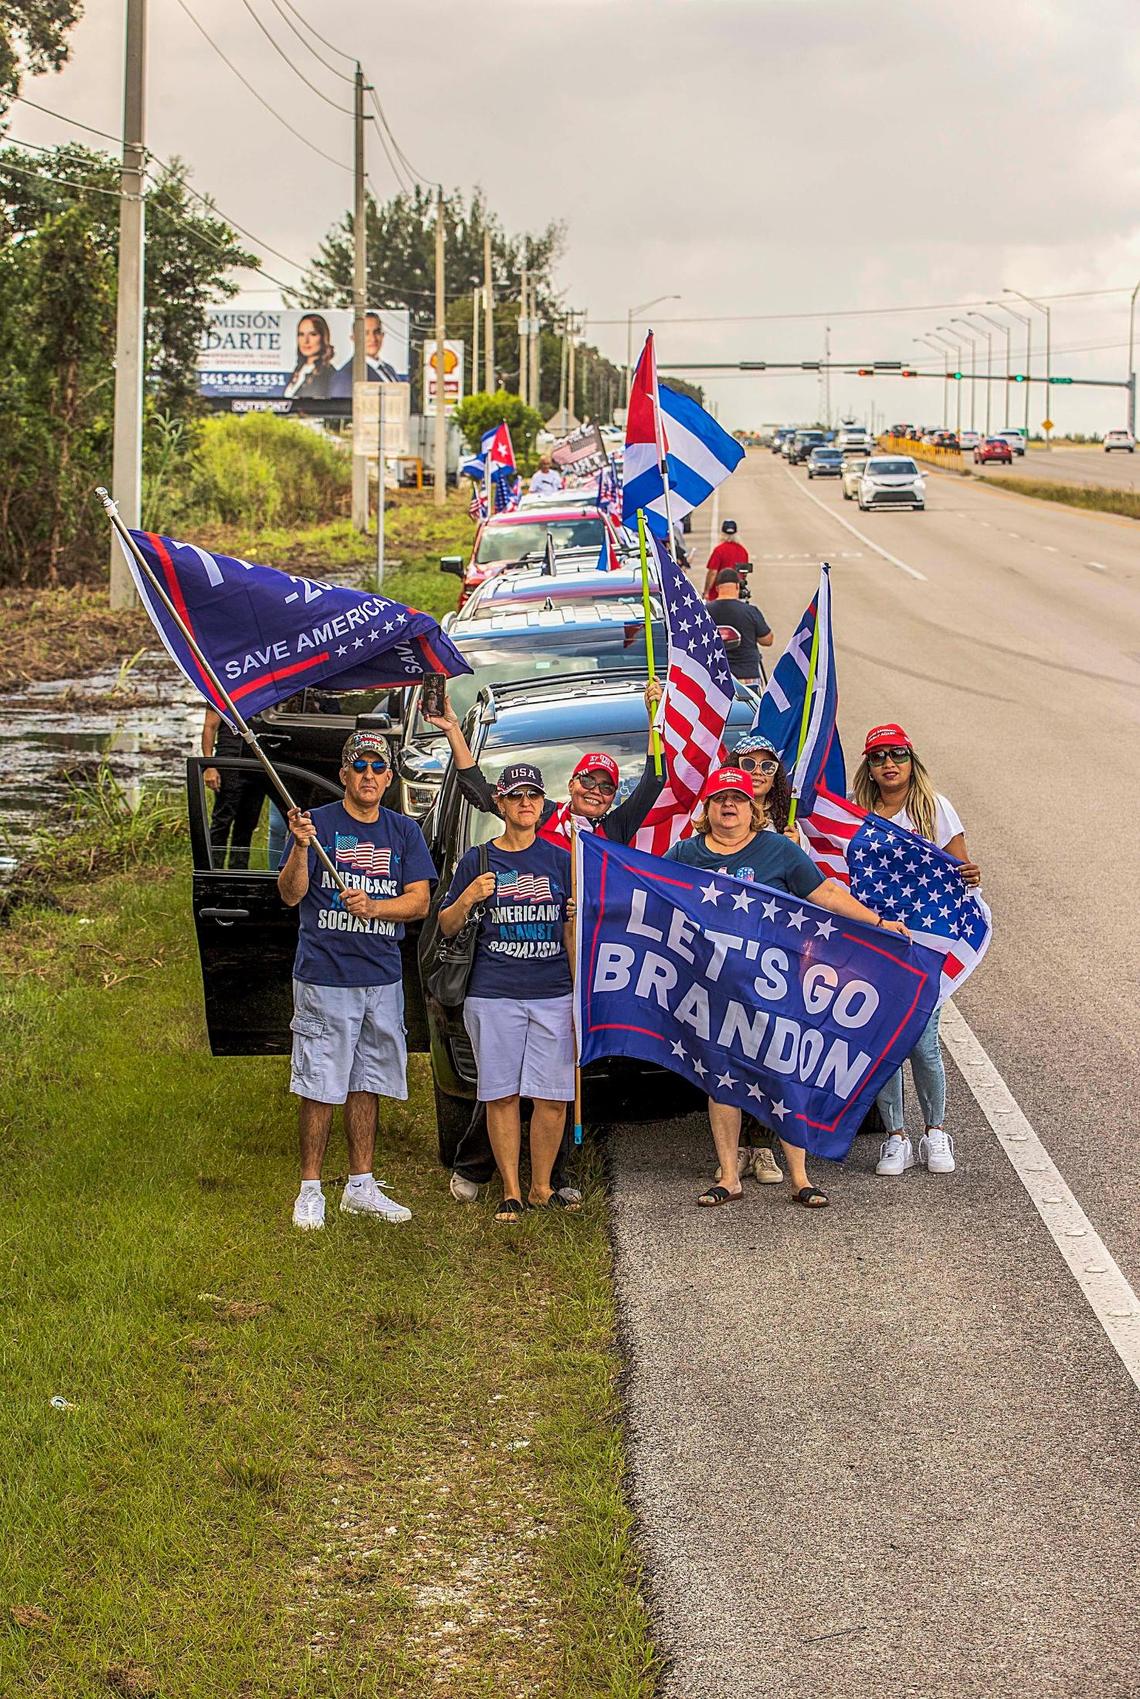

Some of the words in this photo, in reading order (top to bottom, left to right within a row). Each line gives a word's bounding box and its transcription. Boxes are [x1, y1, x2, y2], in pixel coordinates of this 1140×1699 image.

[225, 640, 290, 680] SAVE
[297, 597, 392, 654] AMERICA
[511, 768, 536, 780] USA
[317, 909, 396, 937] SOCIALISM
[489, 904, 560, 924] AMERICANS
[499, 923, 554, 941] AGAINST
[488, 940, 561, 959] SOCIALISM
[625, 888, 790, 1001] LET'S
[802, 963, 880, 1029] GO
[593, 942, 872, 1100] BRANDON
